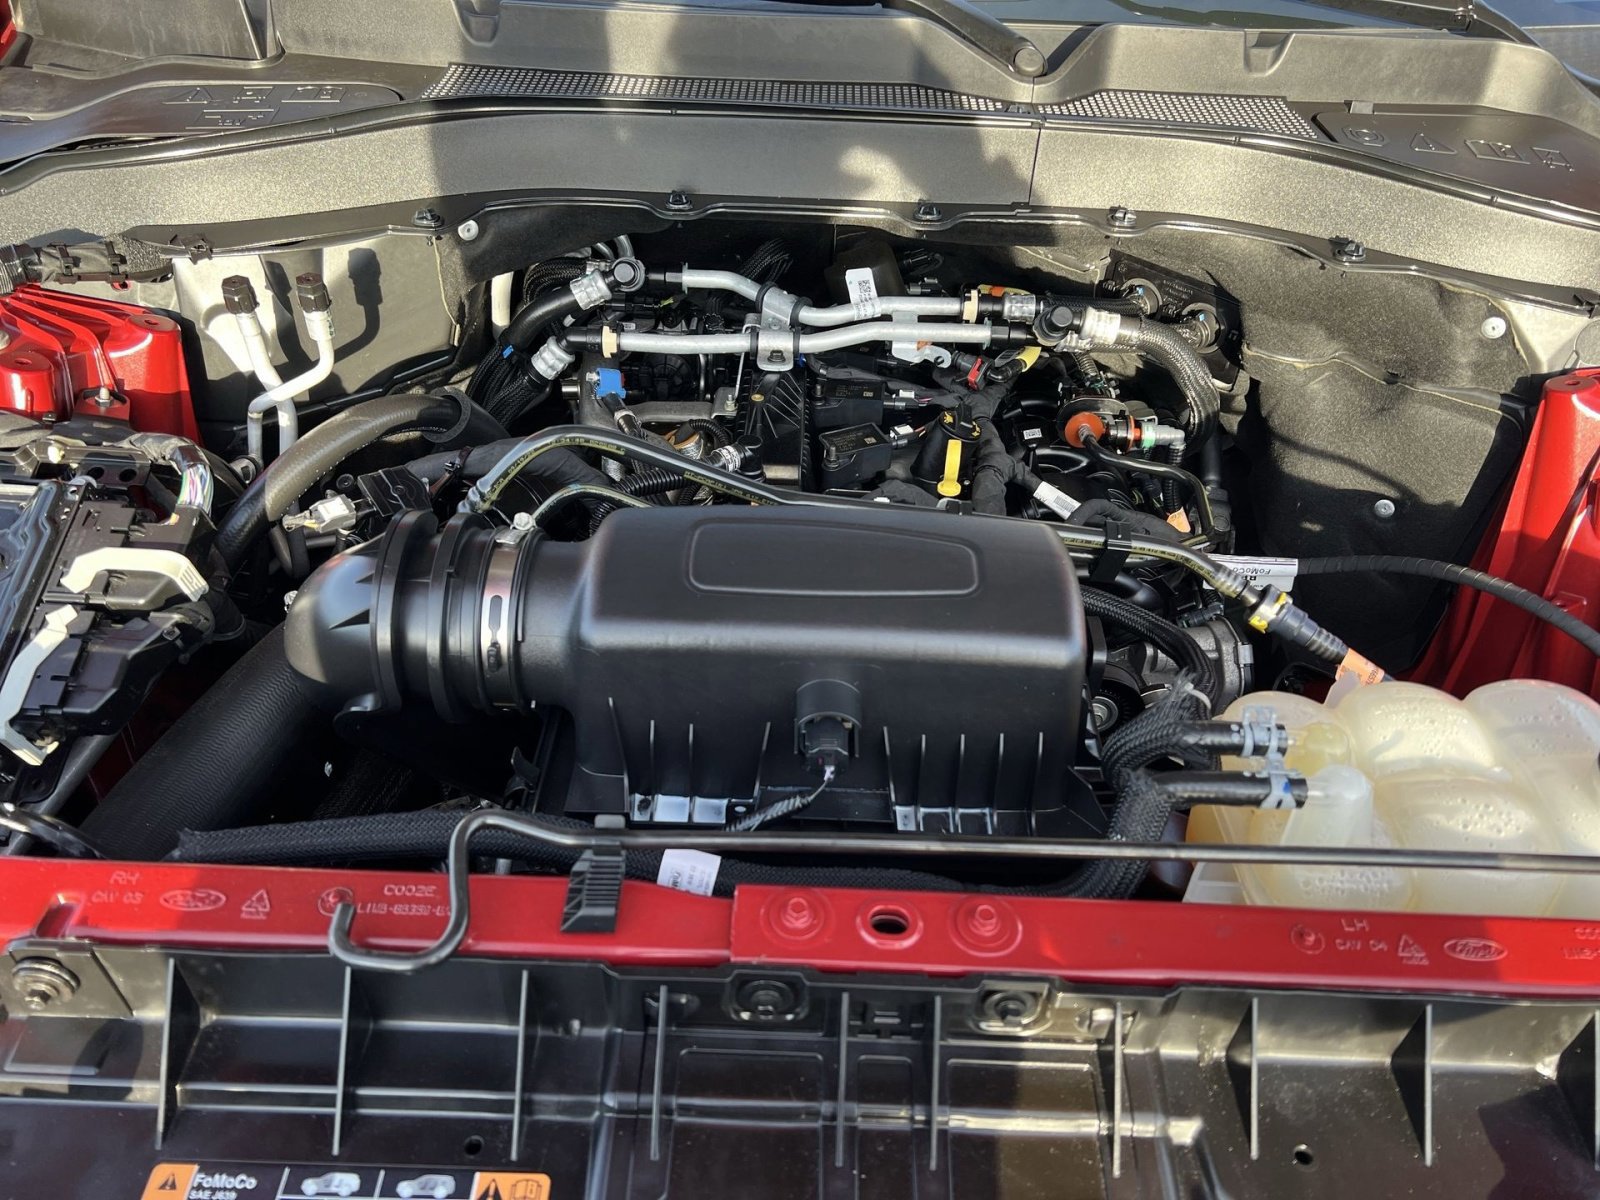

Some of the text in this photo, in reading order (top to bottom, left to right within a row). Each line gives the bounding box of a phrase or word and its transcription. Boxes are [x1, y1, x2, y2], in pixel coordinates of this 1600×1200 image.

[1232, 567, 1271, 575] FoMoCo
[1341, 918, 1369, 931] LH
[193, 1173, 257, 1189] FoMoCo
[189, 1190, 212, 1199] SAE
